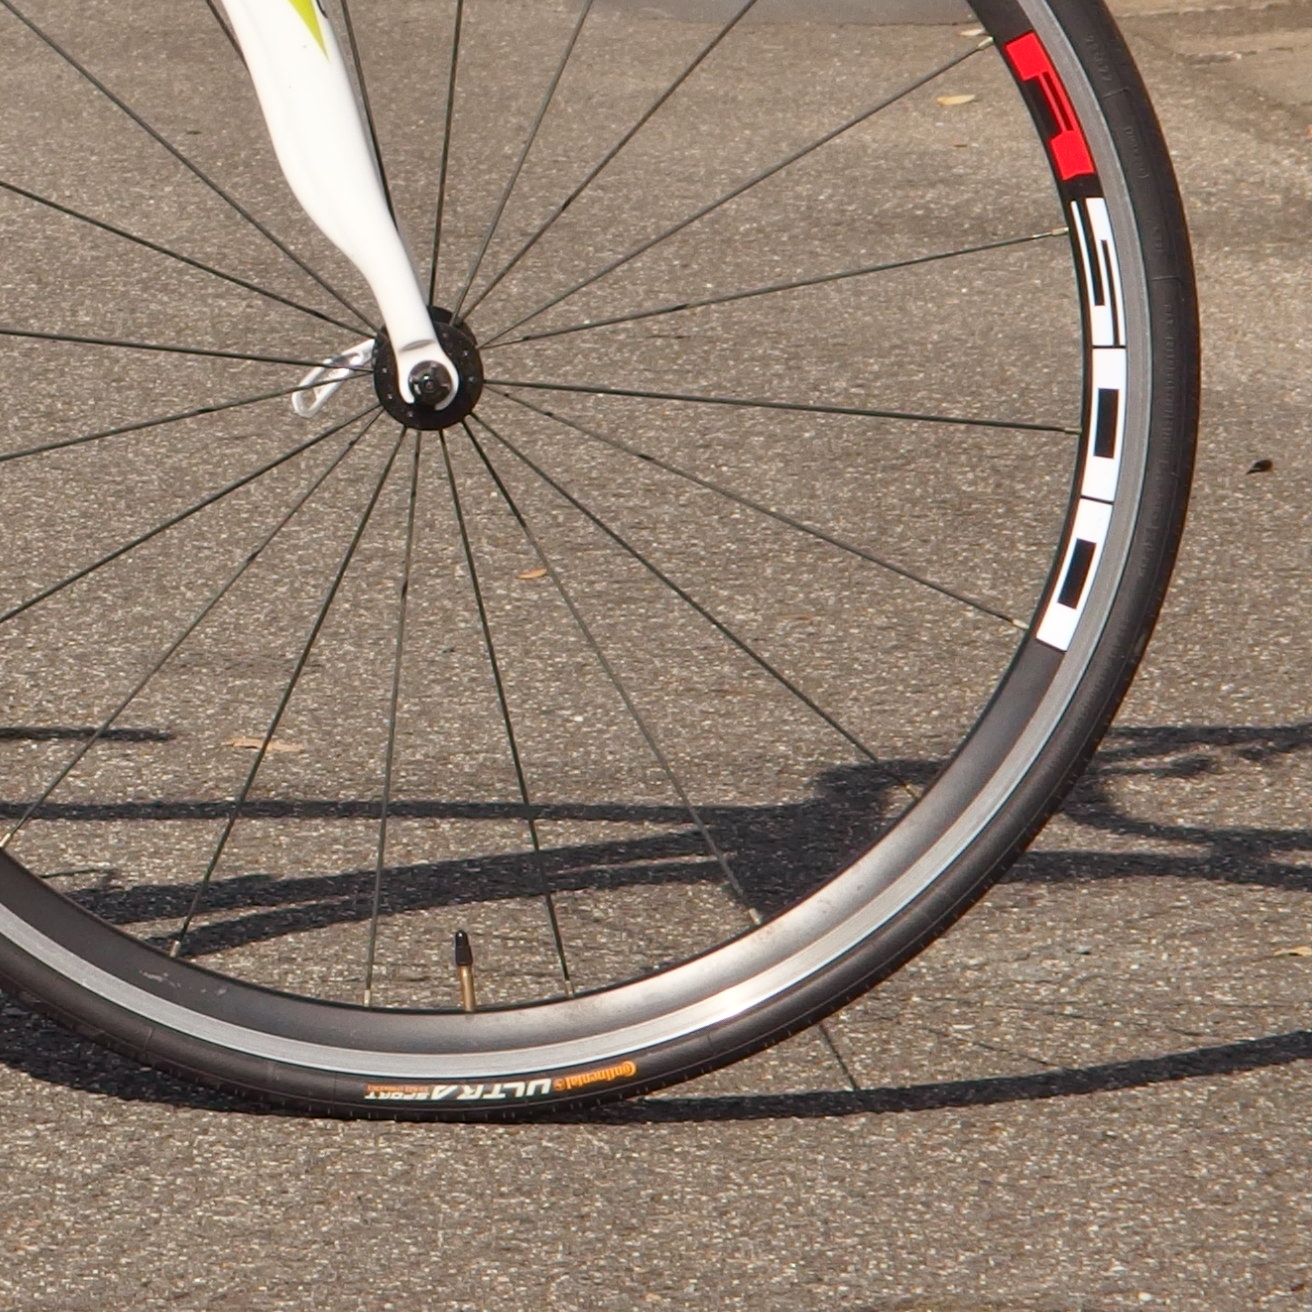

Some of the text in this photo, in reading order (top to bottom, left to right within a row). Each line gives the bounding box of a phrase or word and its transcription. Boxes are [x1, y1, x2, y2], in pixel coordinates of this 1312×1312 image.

[564, 1060, 637, 1089] Continental
[364, 1091, 430, 1100] SPORT
[430, 1077, 552, 1101] ULTRA
